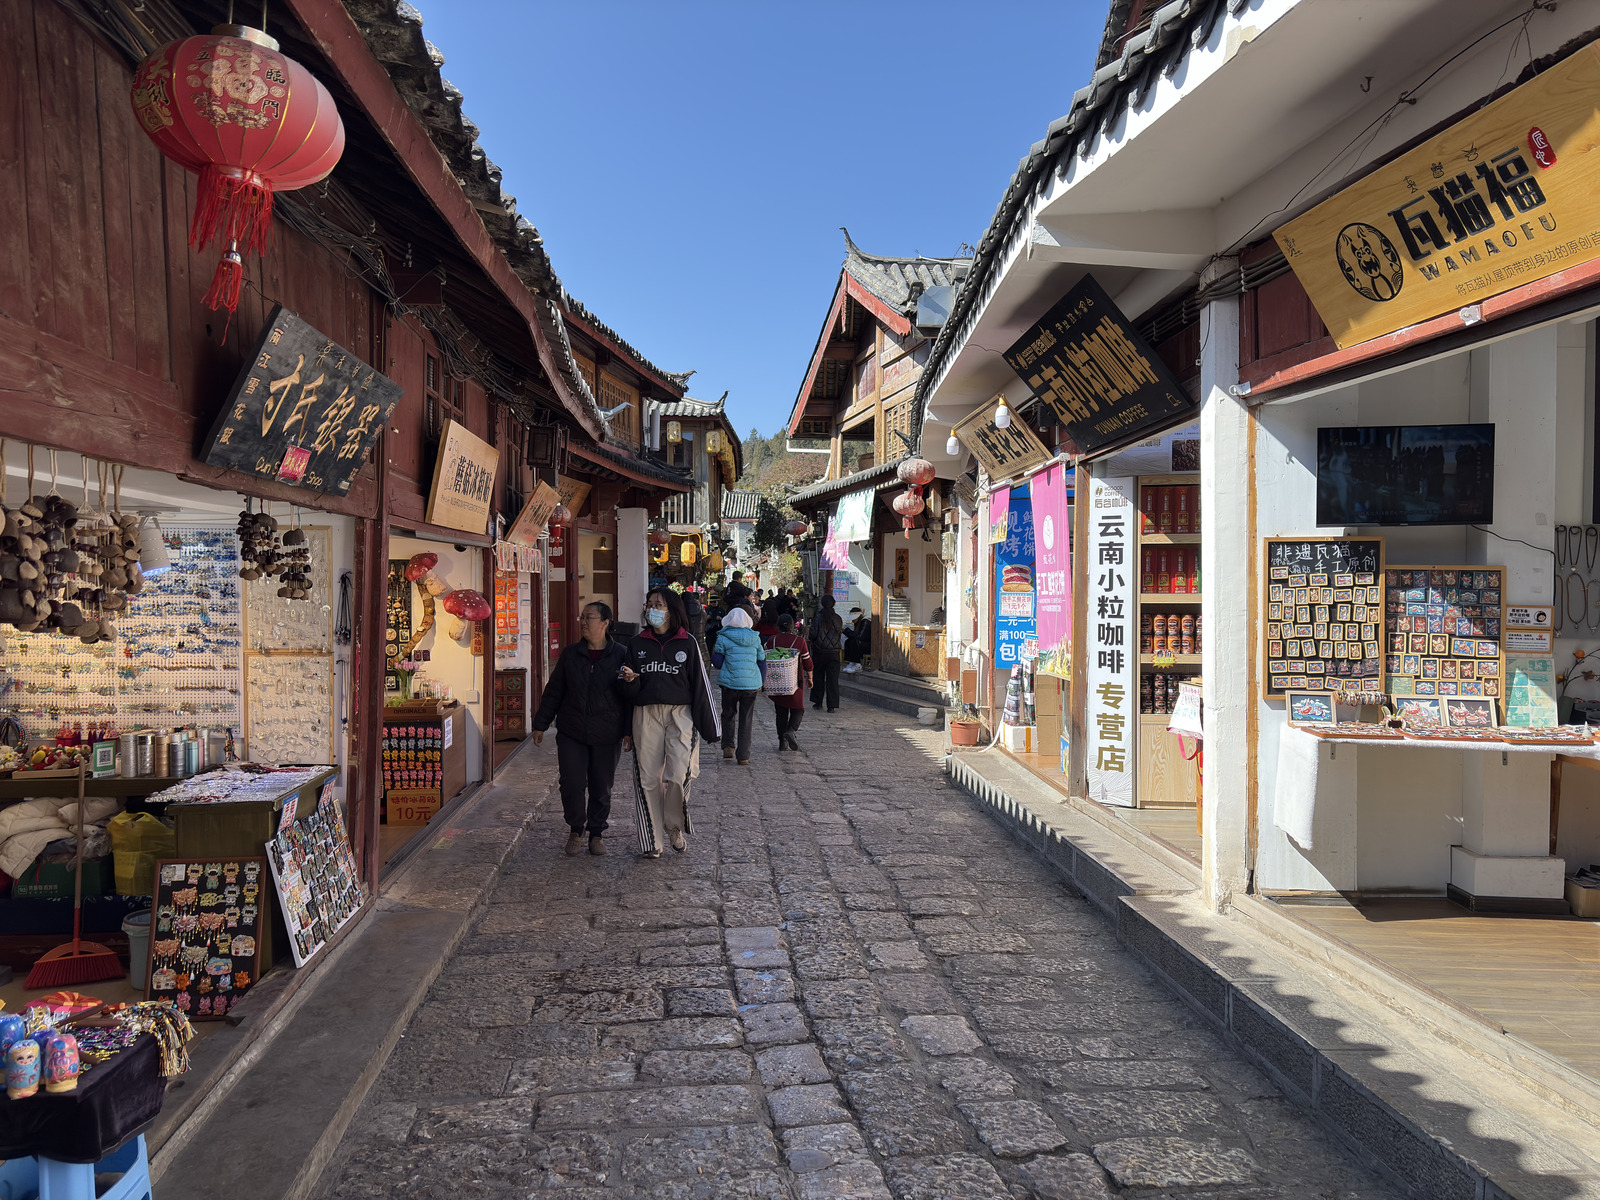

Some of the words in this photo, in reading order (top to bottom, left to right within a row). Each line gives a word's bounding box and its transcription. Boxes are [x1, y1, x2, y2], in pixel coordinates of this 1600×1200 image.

[1387, 146, 1547, 261] 瓦猫福
[1419, 212, 1557, 281] WAMAOFU
[1028, 315, 1160, 426] 云南小粒咖啡
[1094, 418, 1122, 436] YUNNAN
[1118, 403, 1149, 425] COFFEE
[306, 471, 324, 489] Shop
[1095, 498, 1128, 508] 后谷咖啡
[1314, 555, 1376, 574] 手工原创
[640, 661, 680, 675] adidas
[396, 806, 432, 821] 10元
